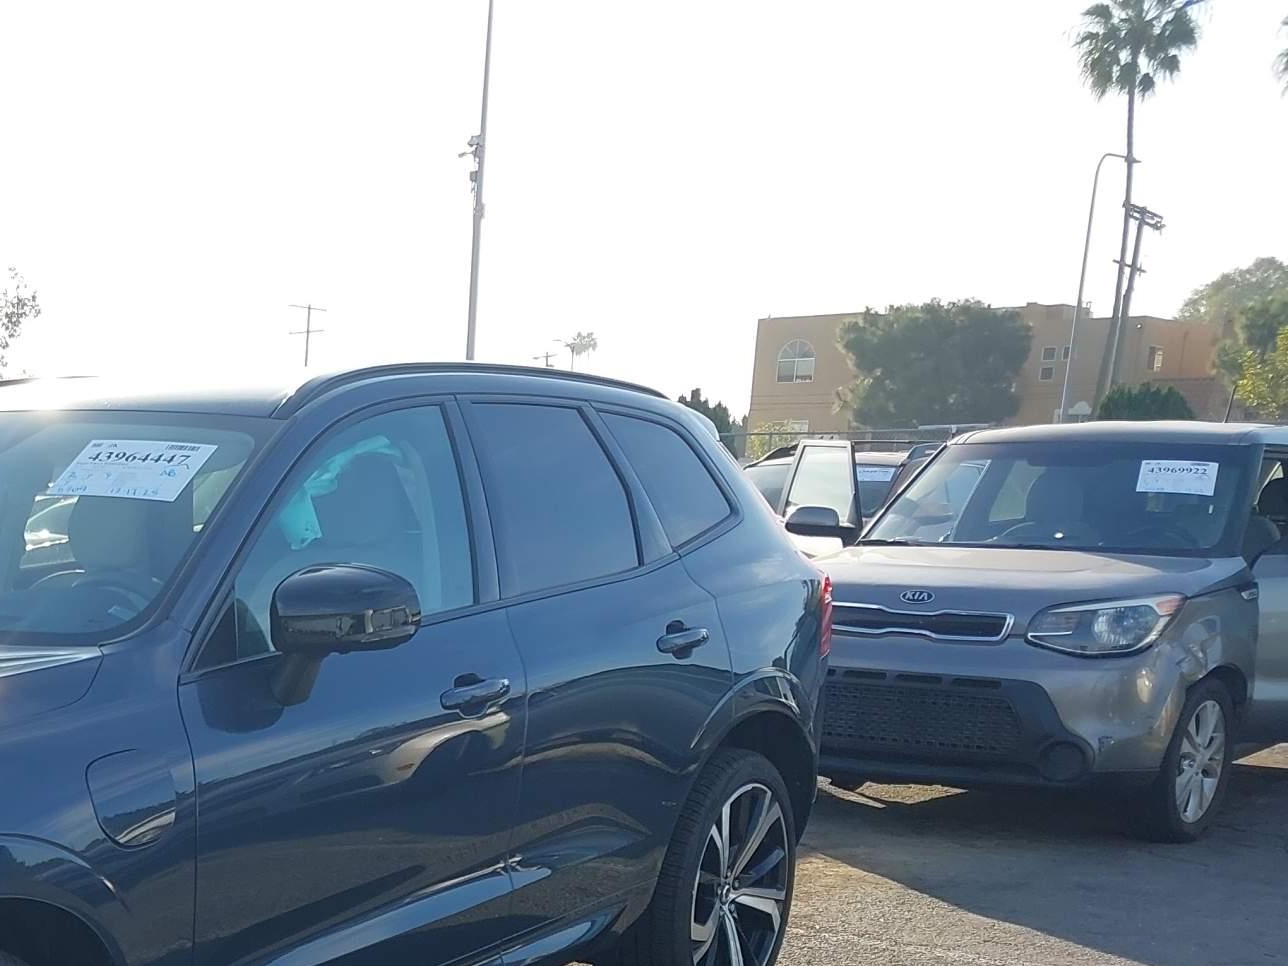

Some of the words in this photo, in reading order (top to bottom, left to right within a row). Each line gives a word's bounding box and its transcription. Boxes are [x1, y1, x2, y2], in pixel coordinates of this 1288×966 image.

[88, 451, 191, 465] 43964447
[1147, 466, 1208, 475] 43969922
[904, 591, 929, 601] KIA
